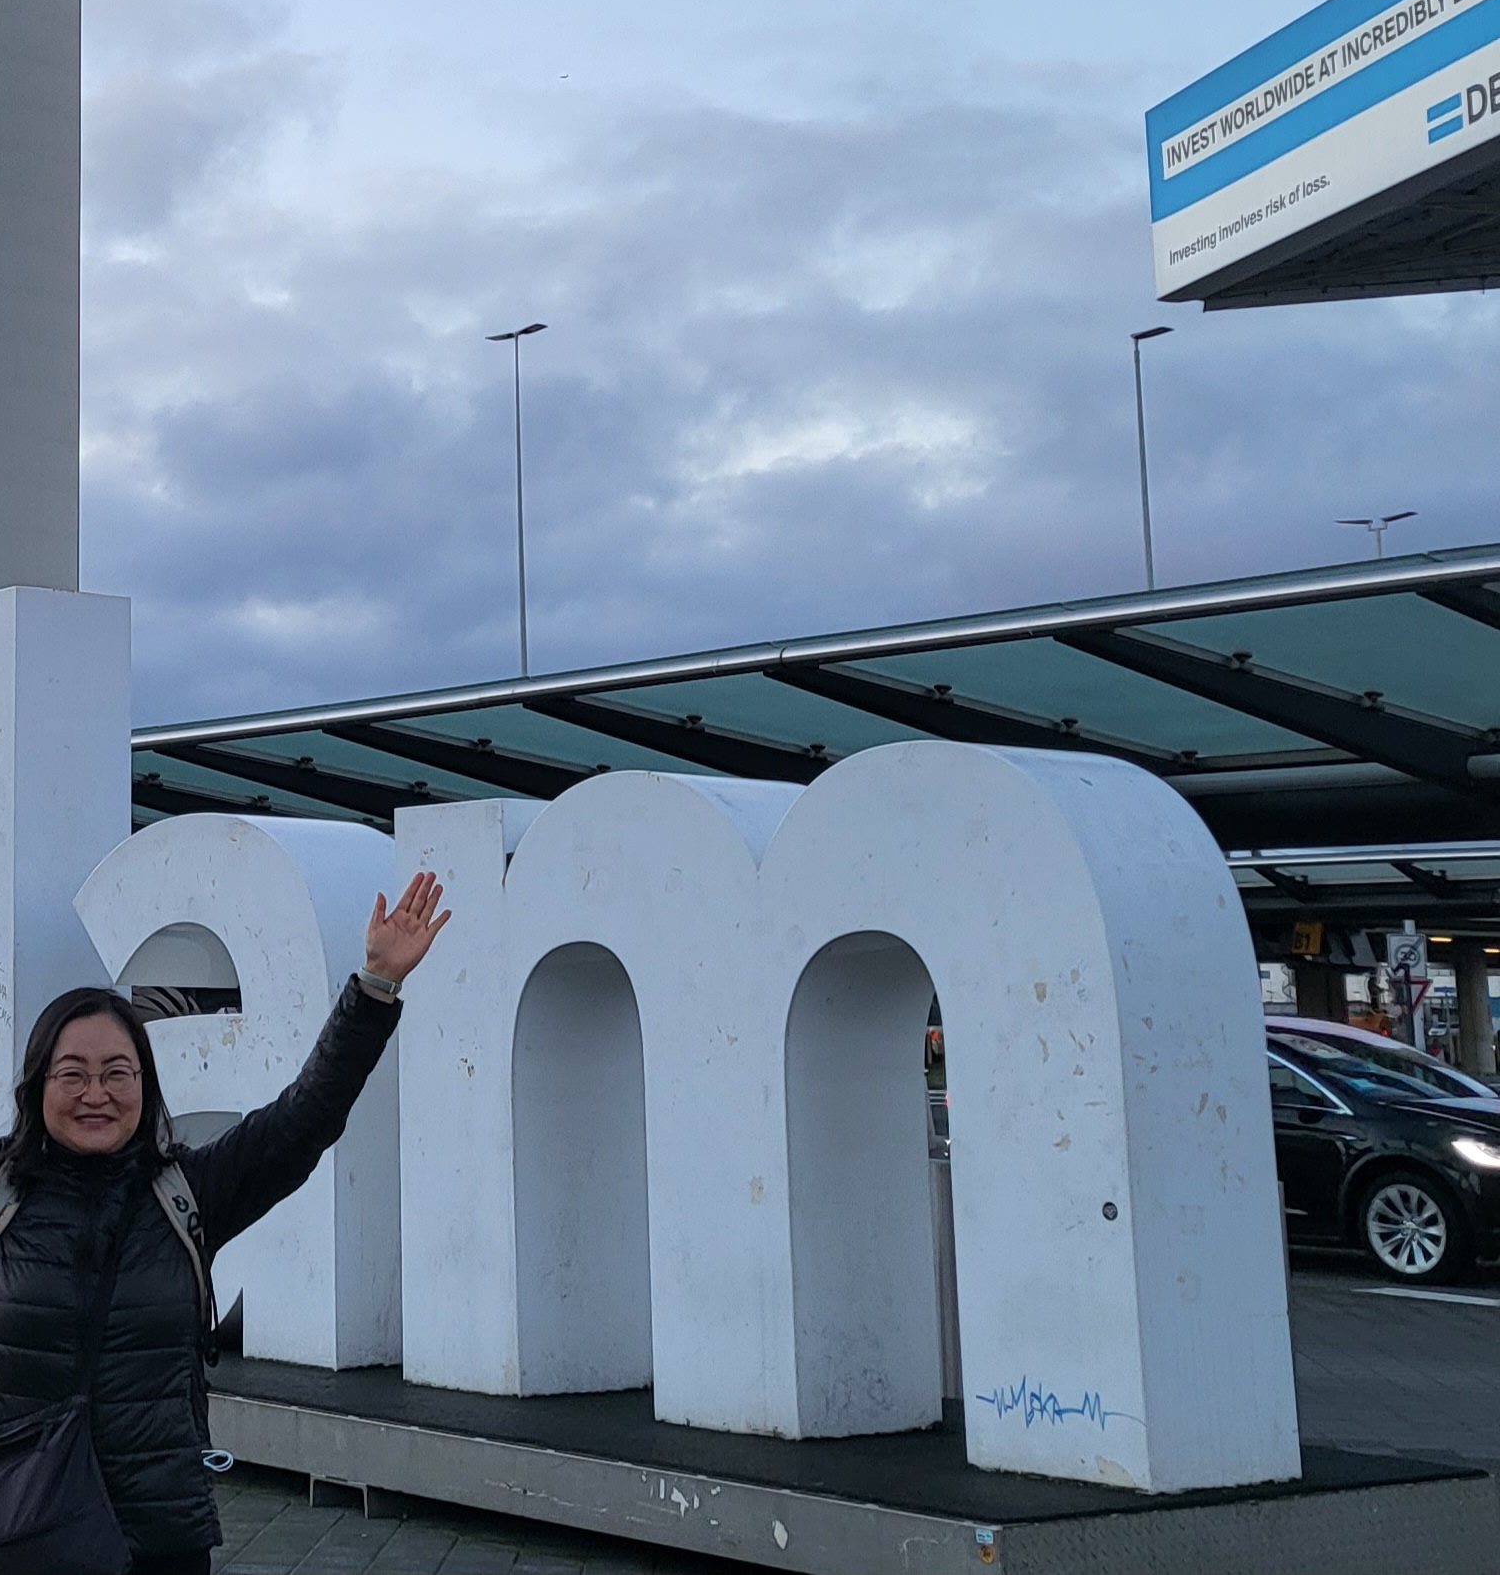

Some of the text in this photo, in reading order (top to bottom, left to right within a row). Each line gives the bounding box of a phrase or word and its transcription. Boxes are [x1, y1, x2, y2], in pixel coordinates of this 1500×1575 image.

[1166, 121, 1218, 169] INVEST
[1219, 63, 1316, 138] WORLDWIDE
[1318, 49, 1339, 83] AT
[1168, 174, 1331, 266] Investing involves risk of loss.
